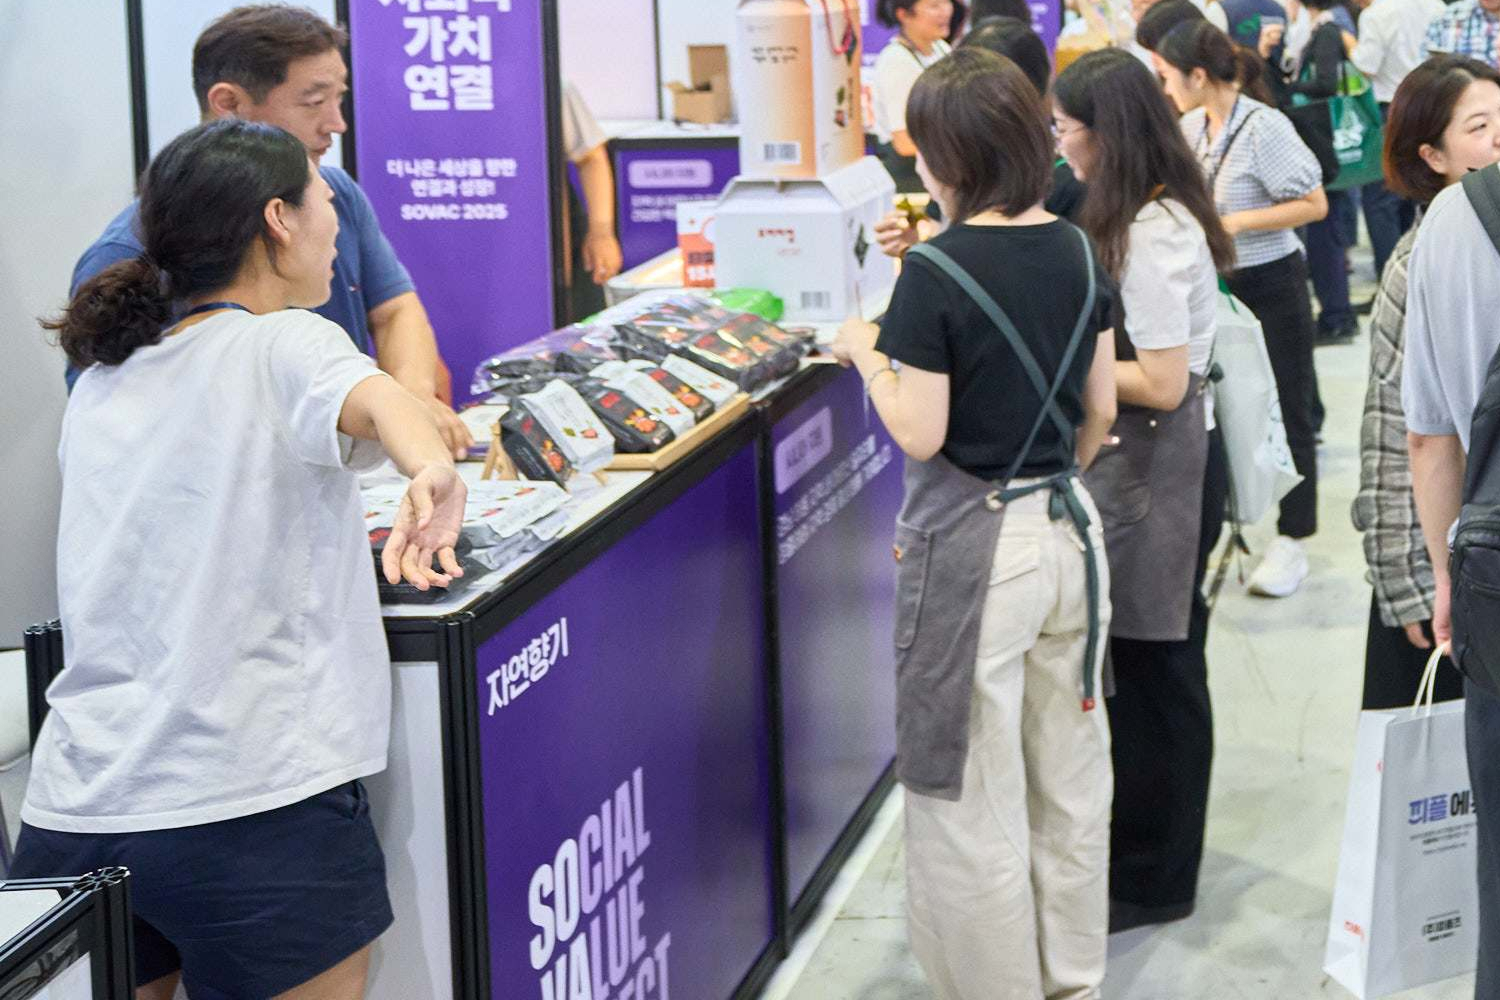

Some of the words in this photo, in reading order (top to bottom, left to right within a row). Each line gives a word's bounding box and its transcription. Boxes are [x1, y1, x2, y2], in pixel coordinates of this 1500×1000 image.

[403, 15, 492, 62] 가치
[403, 64, 495, 111] 연결
[400, 203, 461, 221] SOVAC
[462, 203, 509, 221] 2025
[486, 617, 569, 716] 자연향기
[528, 766, 651, 971] SOCIAL
